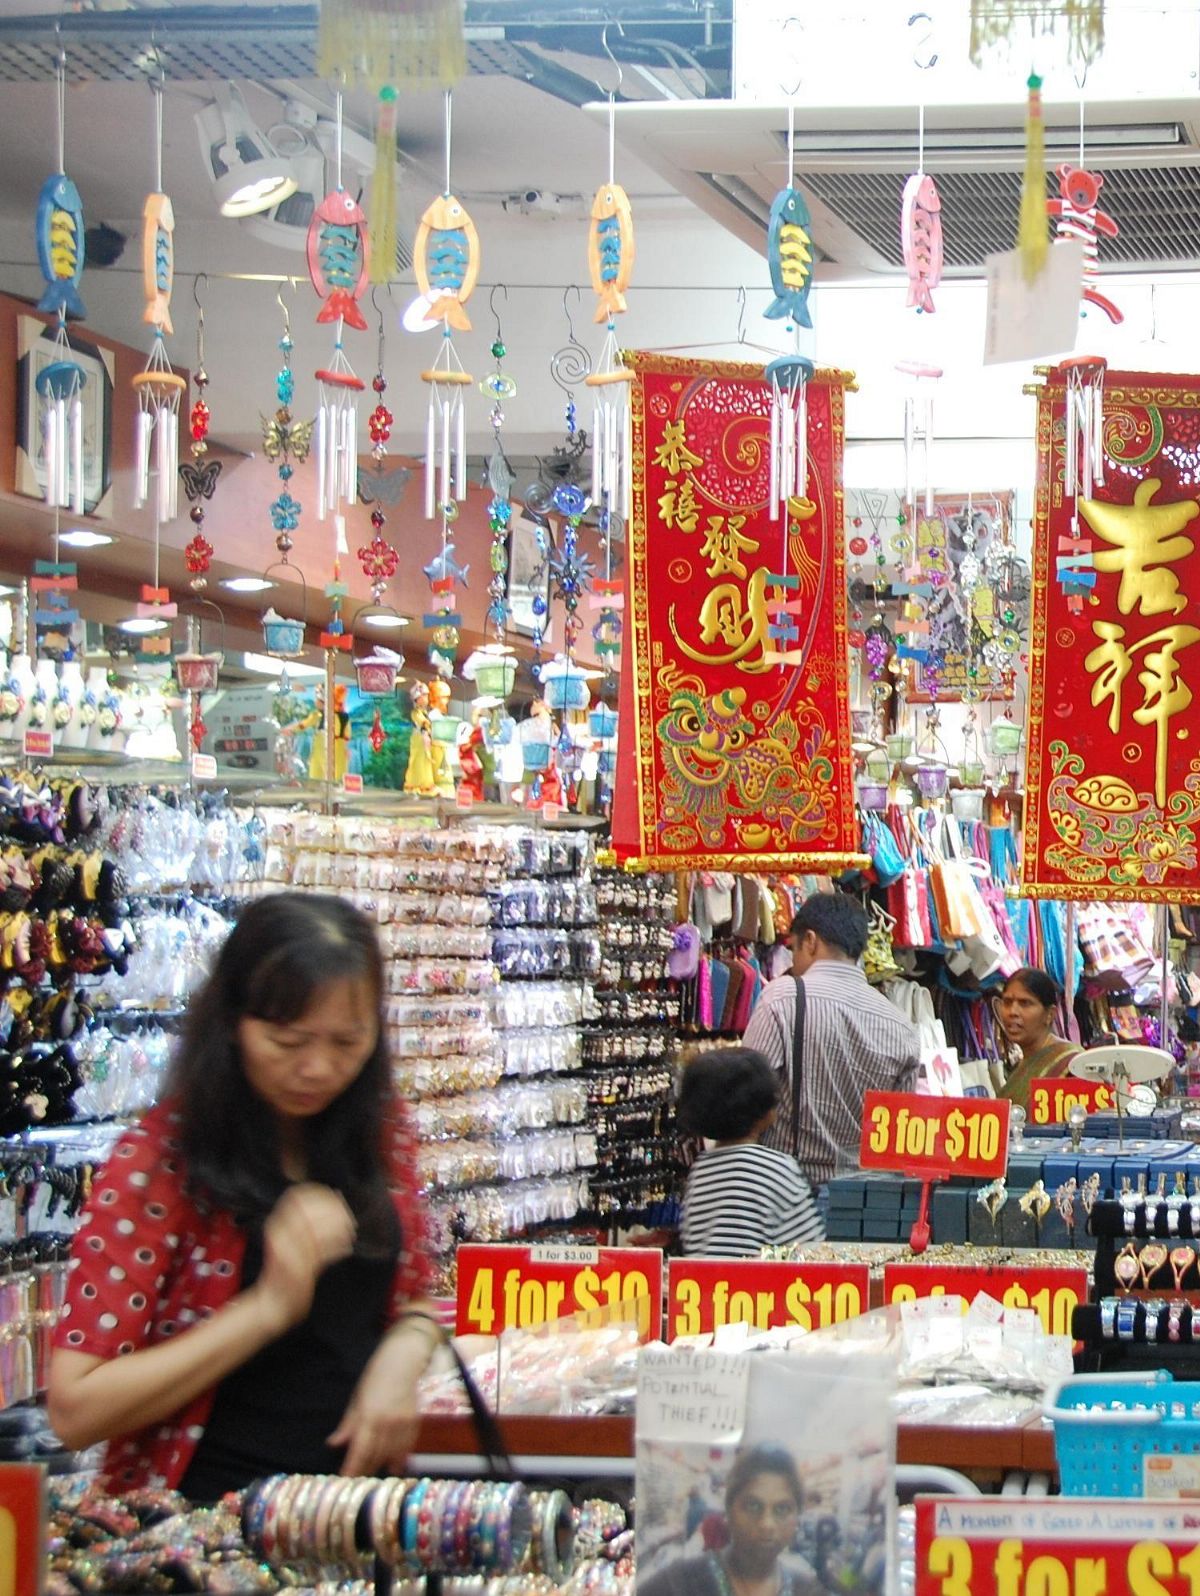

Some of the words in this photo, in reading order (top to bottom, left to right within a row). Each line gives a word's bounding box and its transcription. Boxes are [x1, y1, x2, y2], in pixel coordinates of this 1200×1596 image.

[870, 1105, 890, 1153] 3
[895, 1108, 940, 1156] for
[945, 1107, 1000, 1162] $10
[1034, 1088, 1049, 1124] 3
[1055, 1089, 1089, 1123] for
[546, 1250, 561, 1260] for
[564, 1250, 593, 1262] $3.00
[468, 1267, 495, 1332] 4
[503, 1268, 565, 1336] for
[573, 1265, 649, 1334] $10
[676, 1279, 701, 1337] 3
[713, 1280, 775, 1331] for
[785, 1277, 861, 1332] $10
[938, 1505, 953, 1529] A
[927, 1536, 973, 1596] 3
[994, 1538, 1107, 1596] for
